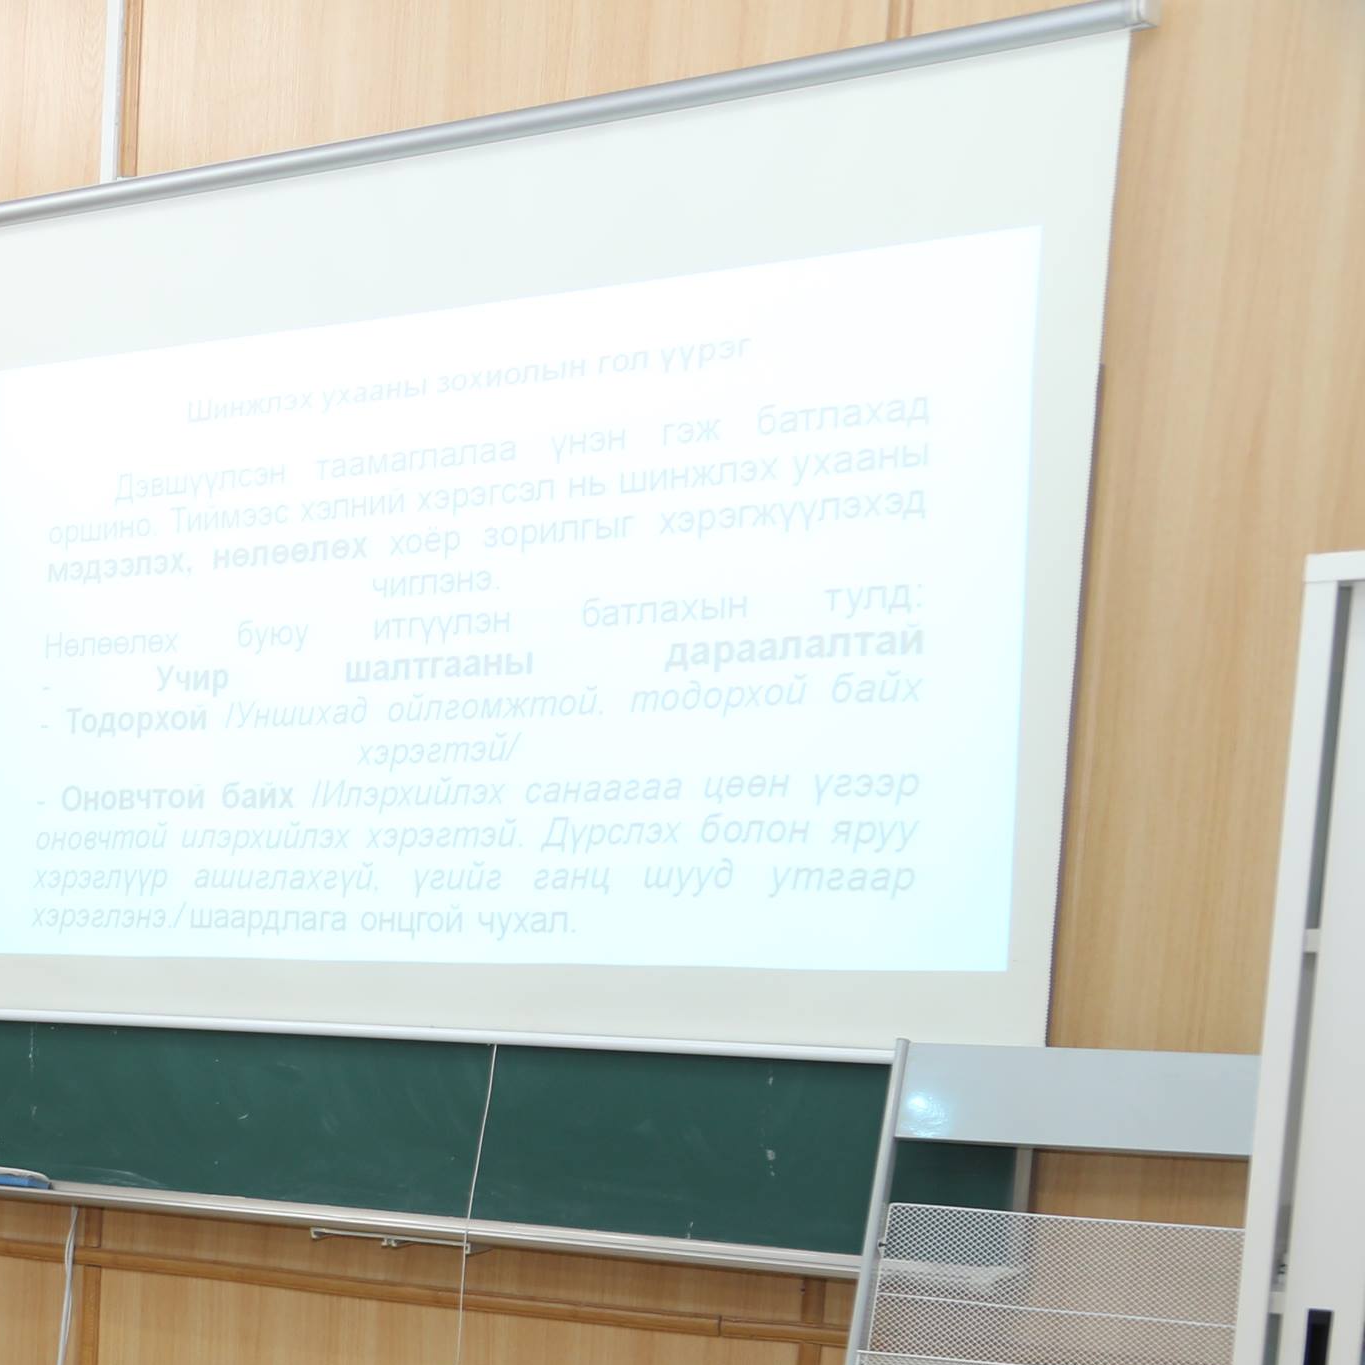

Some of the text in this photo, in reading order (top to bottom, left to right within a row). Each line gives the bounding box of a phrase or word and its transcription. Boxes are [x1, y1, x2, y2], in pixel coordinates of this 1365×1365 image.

[186, 336, 752, 425] Шинжлэх ухааны зохиолын гол үүрэг
[113, 395, 933, 509] Дэвшүүлсэн таамаглалаа үнэн гэж батлахад
[300, 492, 406, 522] хэлний
[417, 478, 556, 517] хэрэгсэл
[567, 474, 609, 499] нь
[618, 456, 779, 496] шинжлэх
[791, 442, 931, 488] ухааны
[212, 534, 369, 571] нөлөөлөх
[388, 527, 462, 560] хоёр
[483, 514, 636, 555] зорилгыг
[658, 487, 928, 540] хэрэгжүүлэхэд
[43, 631, 182, 660] Нөлөөлөх
[236, 618, 310, 657] буюу
[372, 610, 513, 642] итгүүлэн
[580, 594, 750, 629] батлахын
[155, 664, 230, 698] Учир
[344, 649, 535, 685] шалтгааны
[663, 623, 925, 674] дараалалтай
[64, 704, 208, 739] Тодорхой
[628, 673, 809, 720] тодорхой
[830, 670, 926, 705] байх
[60, 783, 206, 813] Оновчтой
[221, 780, 294, 810] байх
[523, 775, 684, 806] санаагаа
[702, 773, 791, 805] цөөн
[813, 772, 922, 807] үгээр
[35, 821, 168, 852] оновчтой
[180, 821, 352, 856] илэрхийлэх
[540, 815, 683, 855] Дүрслэх
[697, 812, 812, 845] болон
[830, 819, 921, 854] яруу
[31, 867, 170, 897] хэрэглүүр
[413, 860, 503, 898] үгийг
[532, 866, 611, 897] ганц
[643, 856, 736, 899] шууд
[767, 864, 918, 901] утгаар
[359, 904, 464, 940] онцгой
